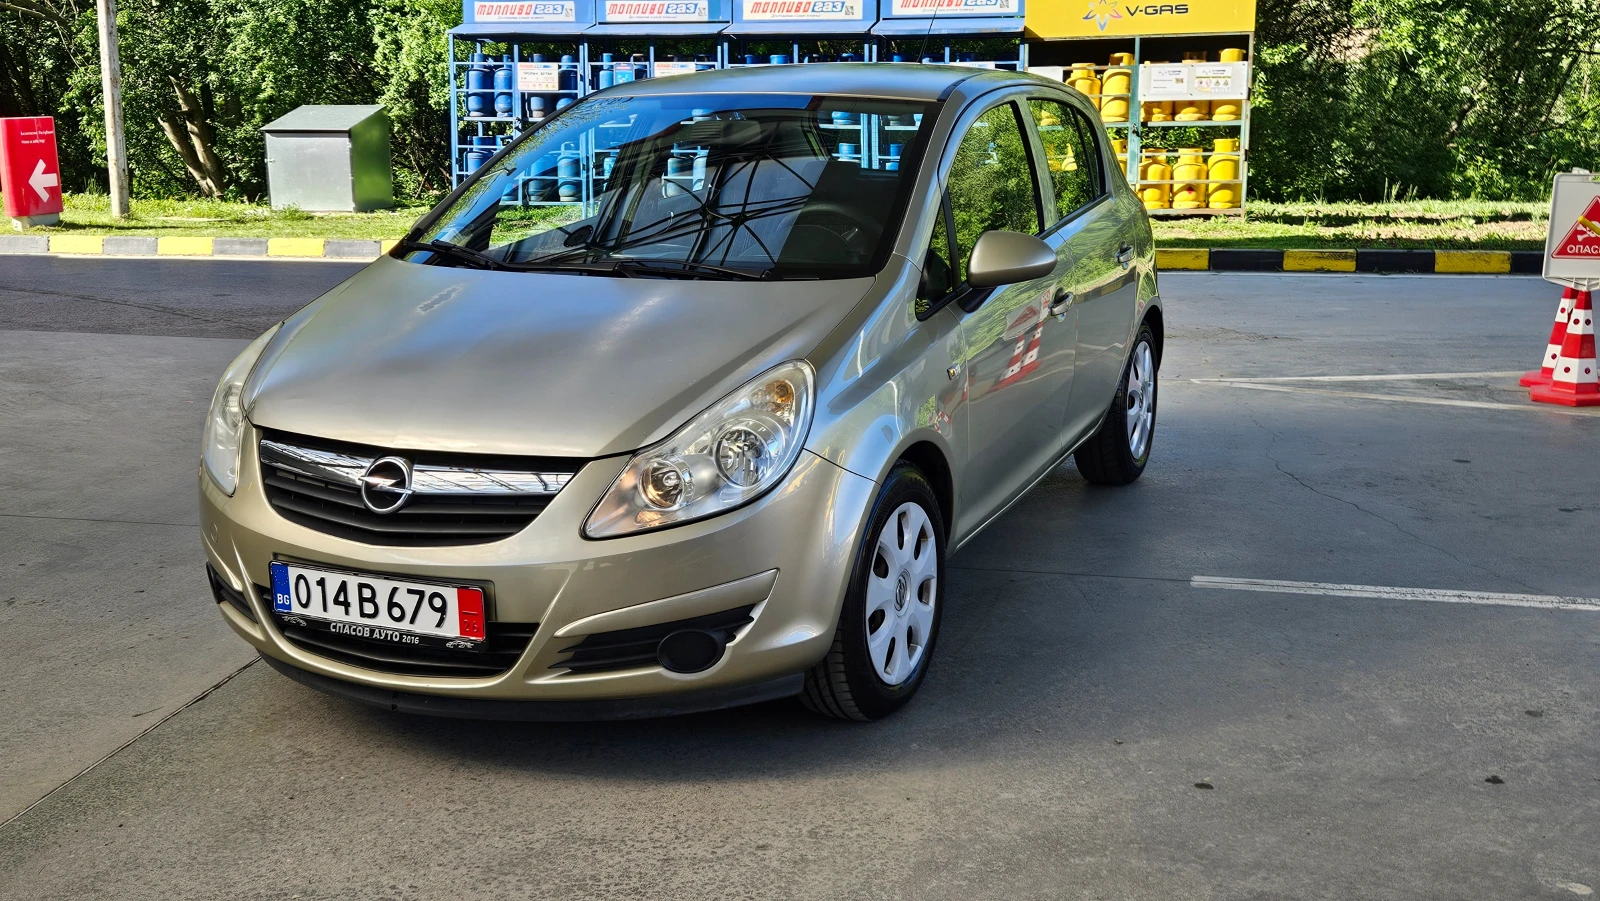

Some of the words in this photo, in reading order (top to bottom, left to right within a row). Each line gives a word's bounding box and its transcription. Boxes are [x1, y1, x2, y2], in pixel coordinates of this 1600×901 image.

[1125, 4, 1189, 17] V-GAS
[1567, 245, 1600, 254] ОПАС
[277, 593, 290, 606] BG
[330, 622, 370, 637] СПАСОВ
[372, 628, 400, 642] АУТО
[402, 635, 420, 644] 2016
